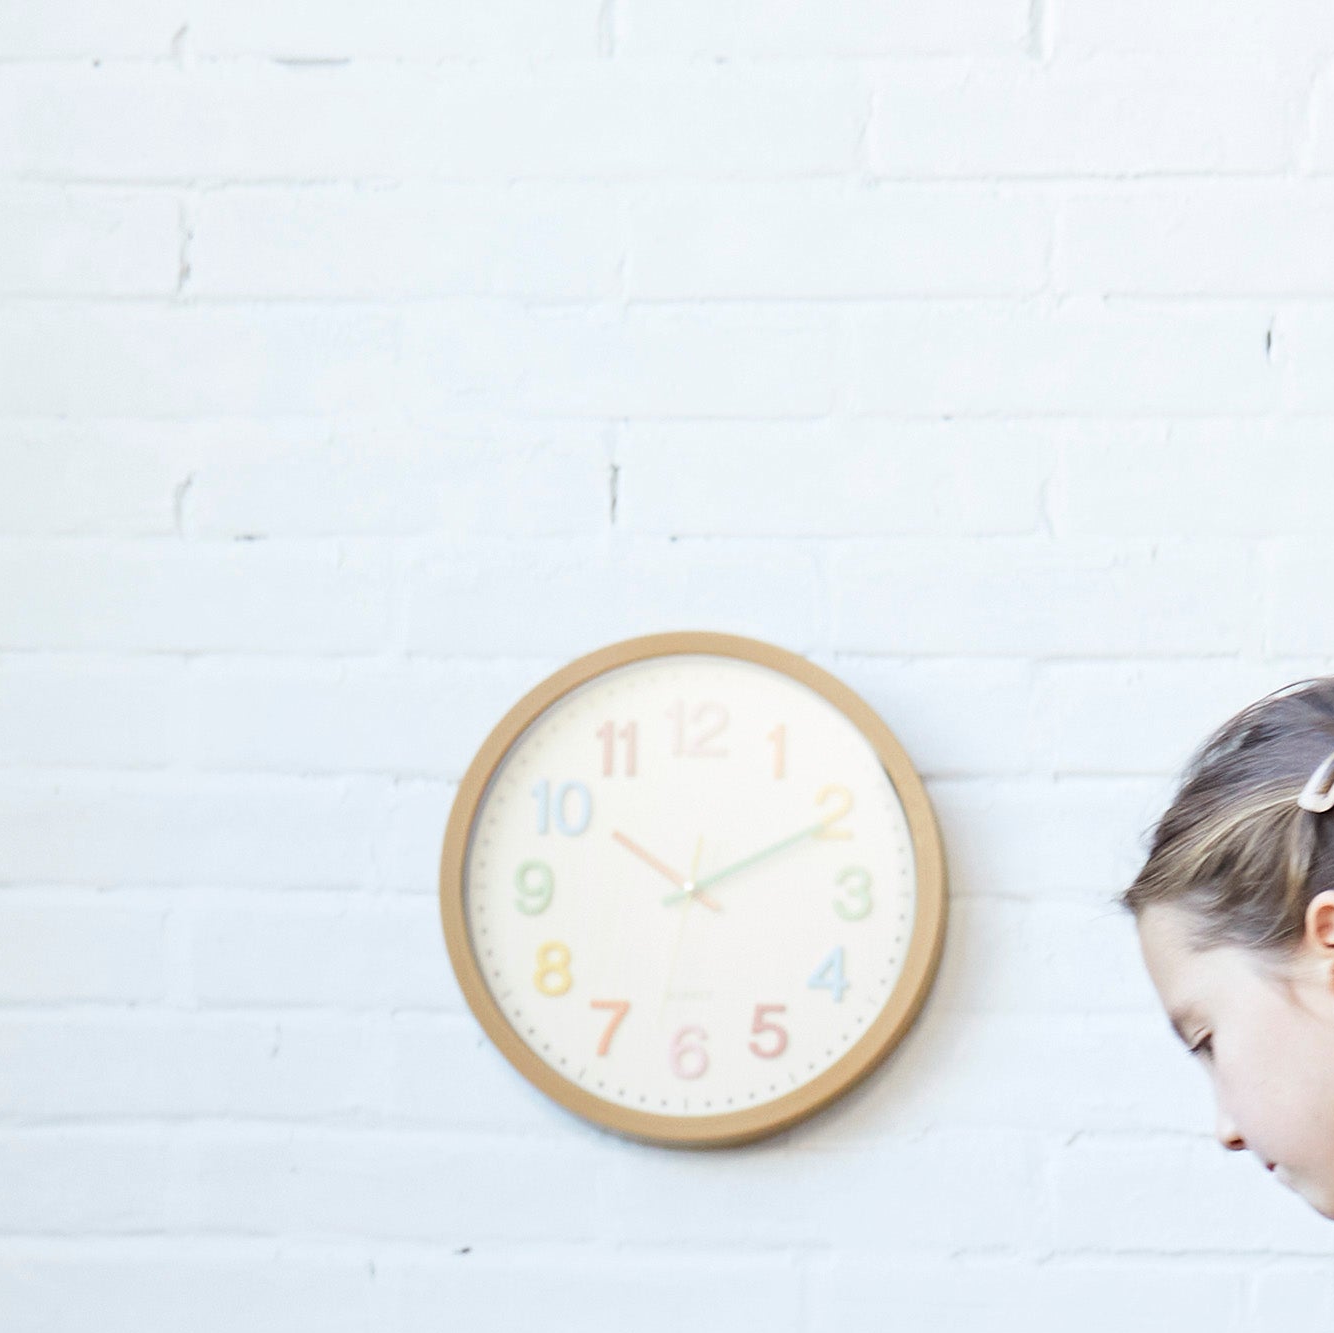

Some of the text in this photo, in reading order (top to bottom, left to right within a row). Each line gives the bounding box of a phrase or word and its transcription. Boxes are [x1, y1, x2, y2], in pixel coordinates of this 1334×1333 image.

[596, 721, 638, 777] 11
[665, 703, 729, 758] 12
[769, 724, 786, 779] 1
[532, 779, 592, 836] 10
[814, 784, 854, 840] 2
[514, 859, 554, 915] 9
[834, 866, 873, 922] 3
[533, 941, 573, 997] 8
[807, 946, 849, 1002] 4
[591, 1000, 630, 1056] 7
[672, 1024, 709, 1080] 6
[748, 1004, 788, 1059] 5
